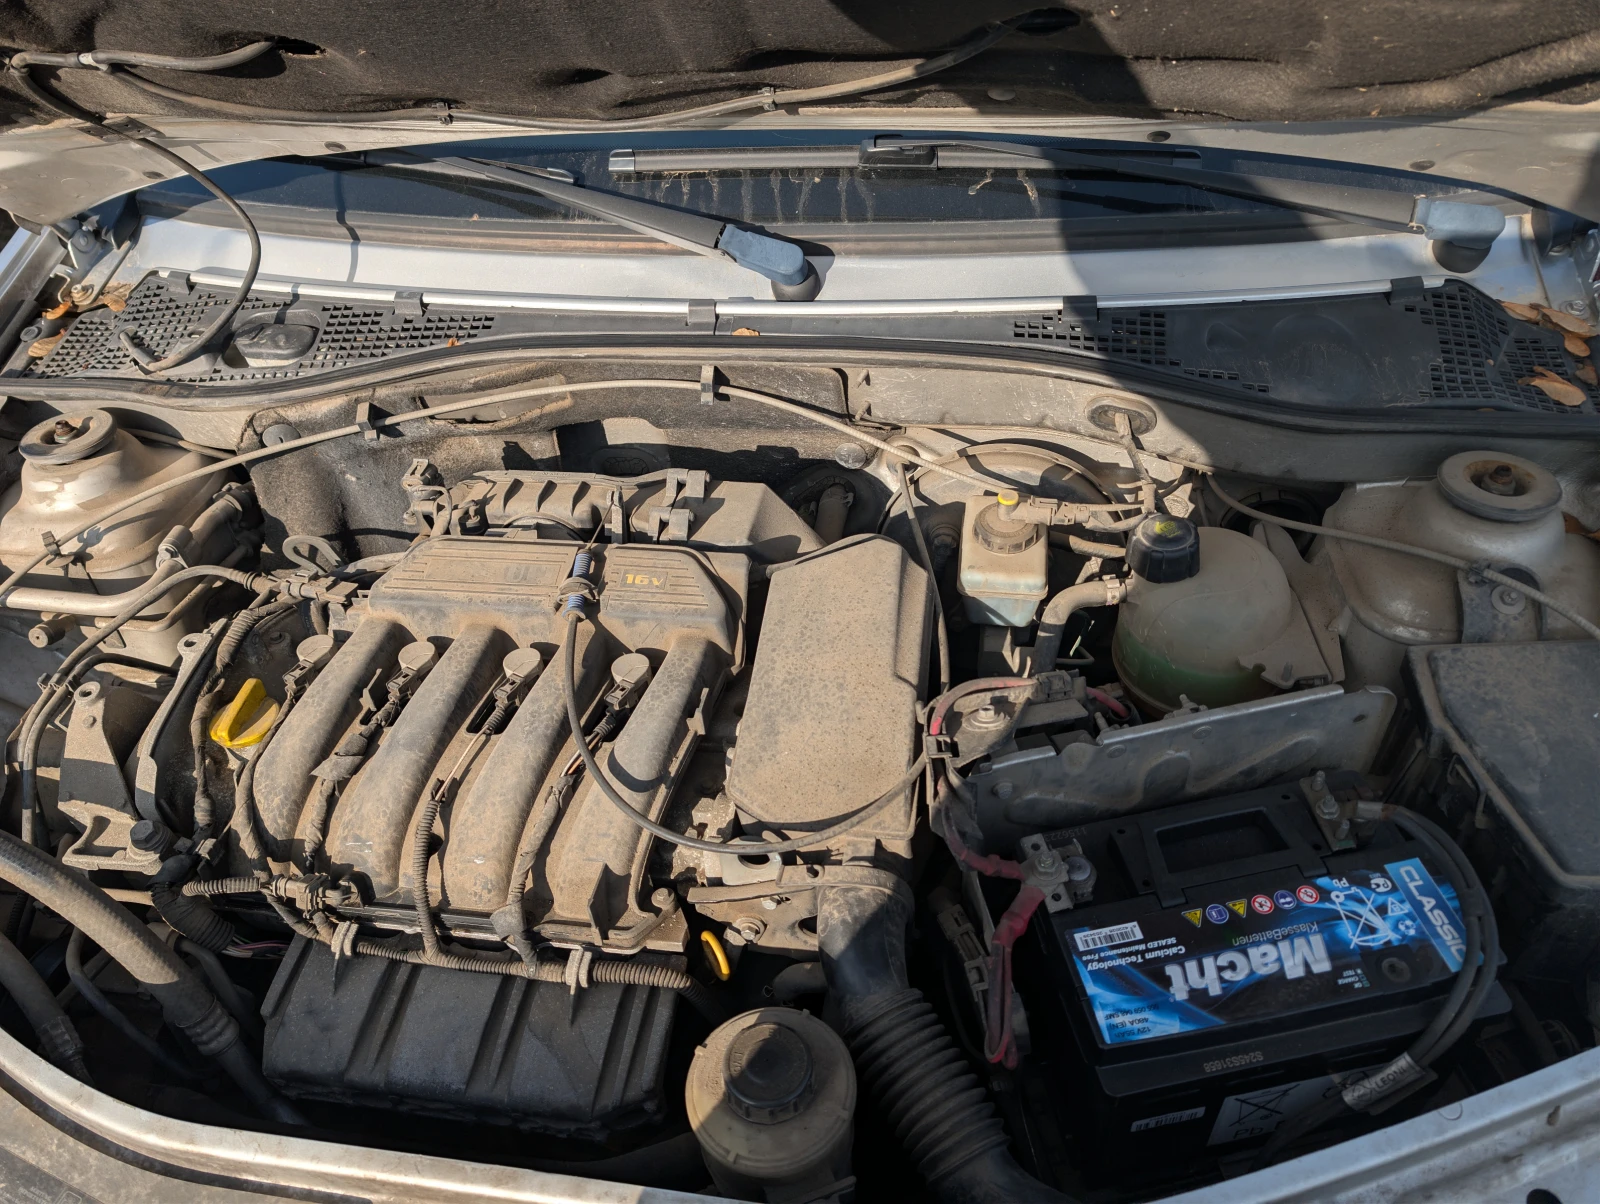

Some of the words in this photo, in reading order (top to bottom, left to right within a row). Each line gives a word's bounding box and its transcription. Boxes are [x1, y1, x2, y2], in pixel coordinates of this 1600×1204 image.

[1332, 877, 1350, 889] Pb
[1232, 921, 1319, 947] KlasseBatterien
[1146, 937, 1177, 948] SEALED
[1082, 953, 1099, 961] Free
[1099, 944, 1146, 957] Maintenance
[1145, 945, 1186, 960] Calcium
[1087, 954, 1143, 972] Technology
[1164, 933, 1333, 1001] Macht
[1137, 1026, 1152, 1036] 12V
[1232, 1126, 1264, 1140] Pb
